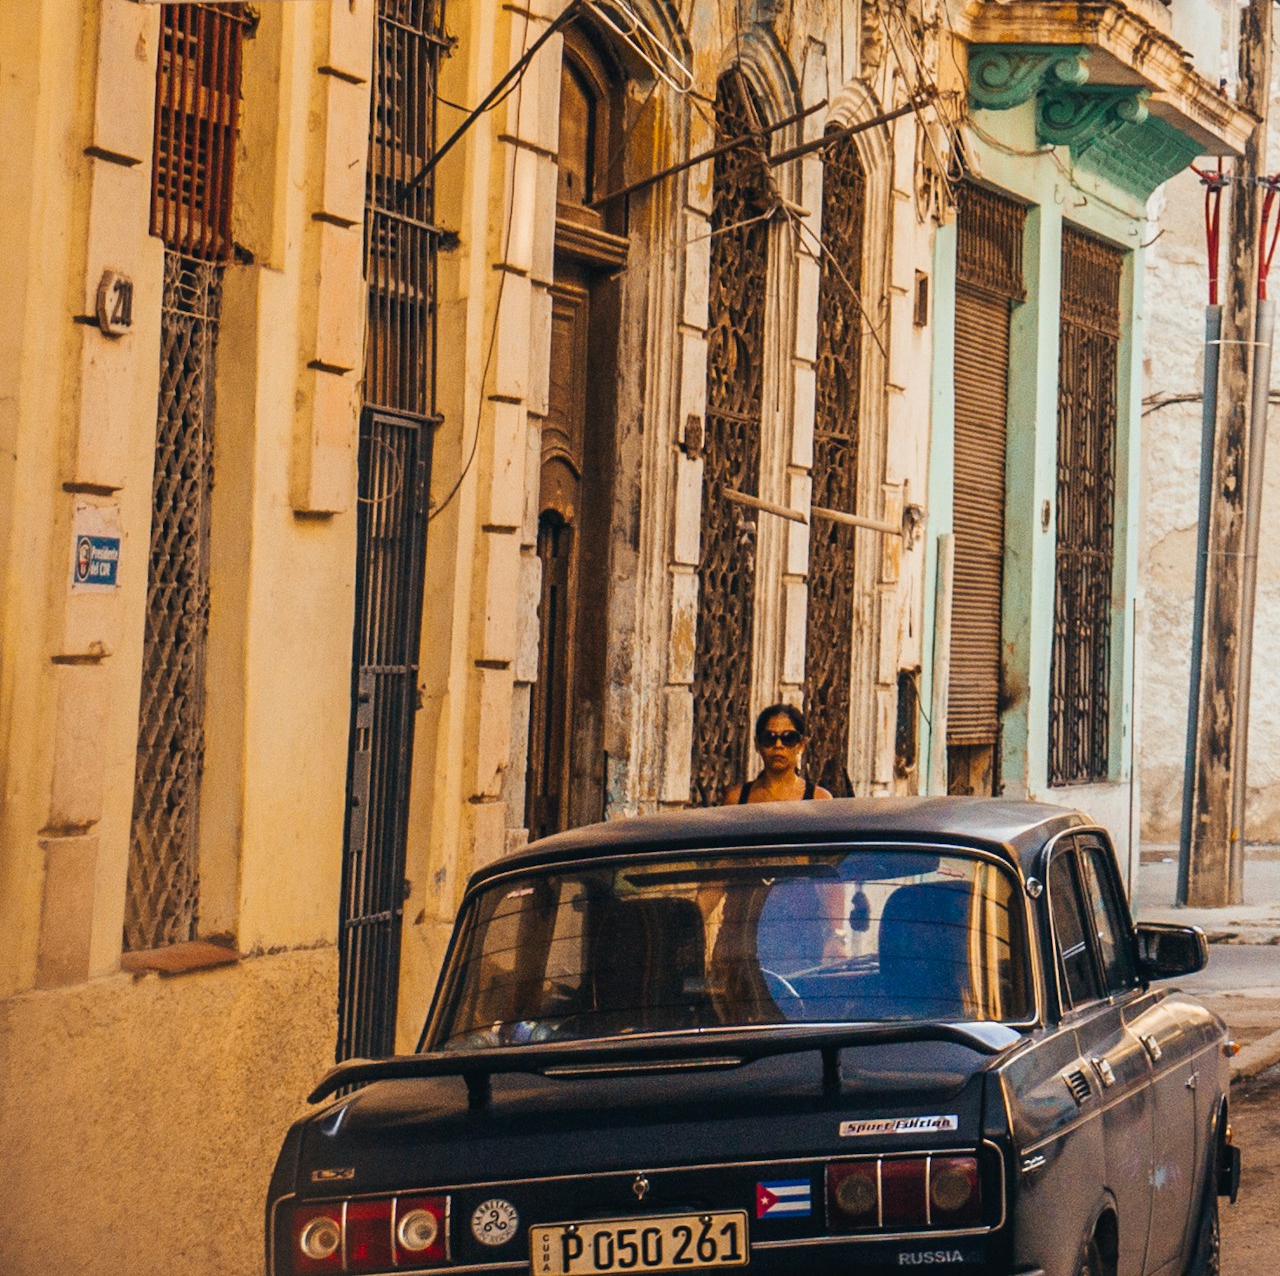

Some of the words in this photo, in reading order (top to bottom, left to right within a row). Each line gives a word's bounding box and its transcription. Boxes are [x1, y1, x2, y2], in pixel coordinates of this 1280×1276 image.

[847, 1122, 891, 1133] Sport
[542, 1233, 551, 1272] CUBA
[561, 1232, 584, 1273] P
[593, 1227, 663, 1271] 050
[671, 1221, 742, 1265] 261
[898, 1249, 964, 1265] RUSSIA
